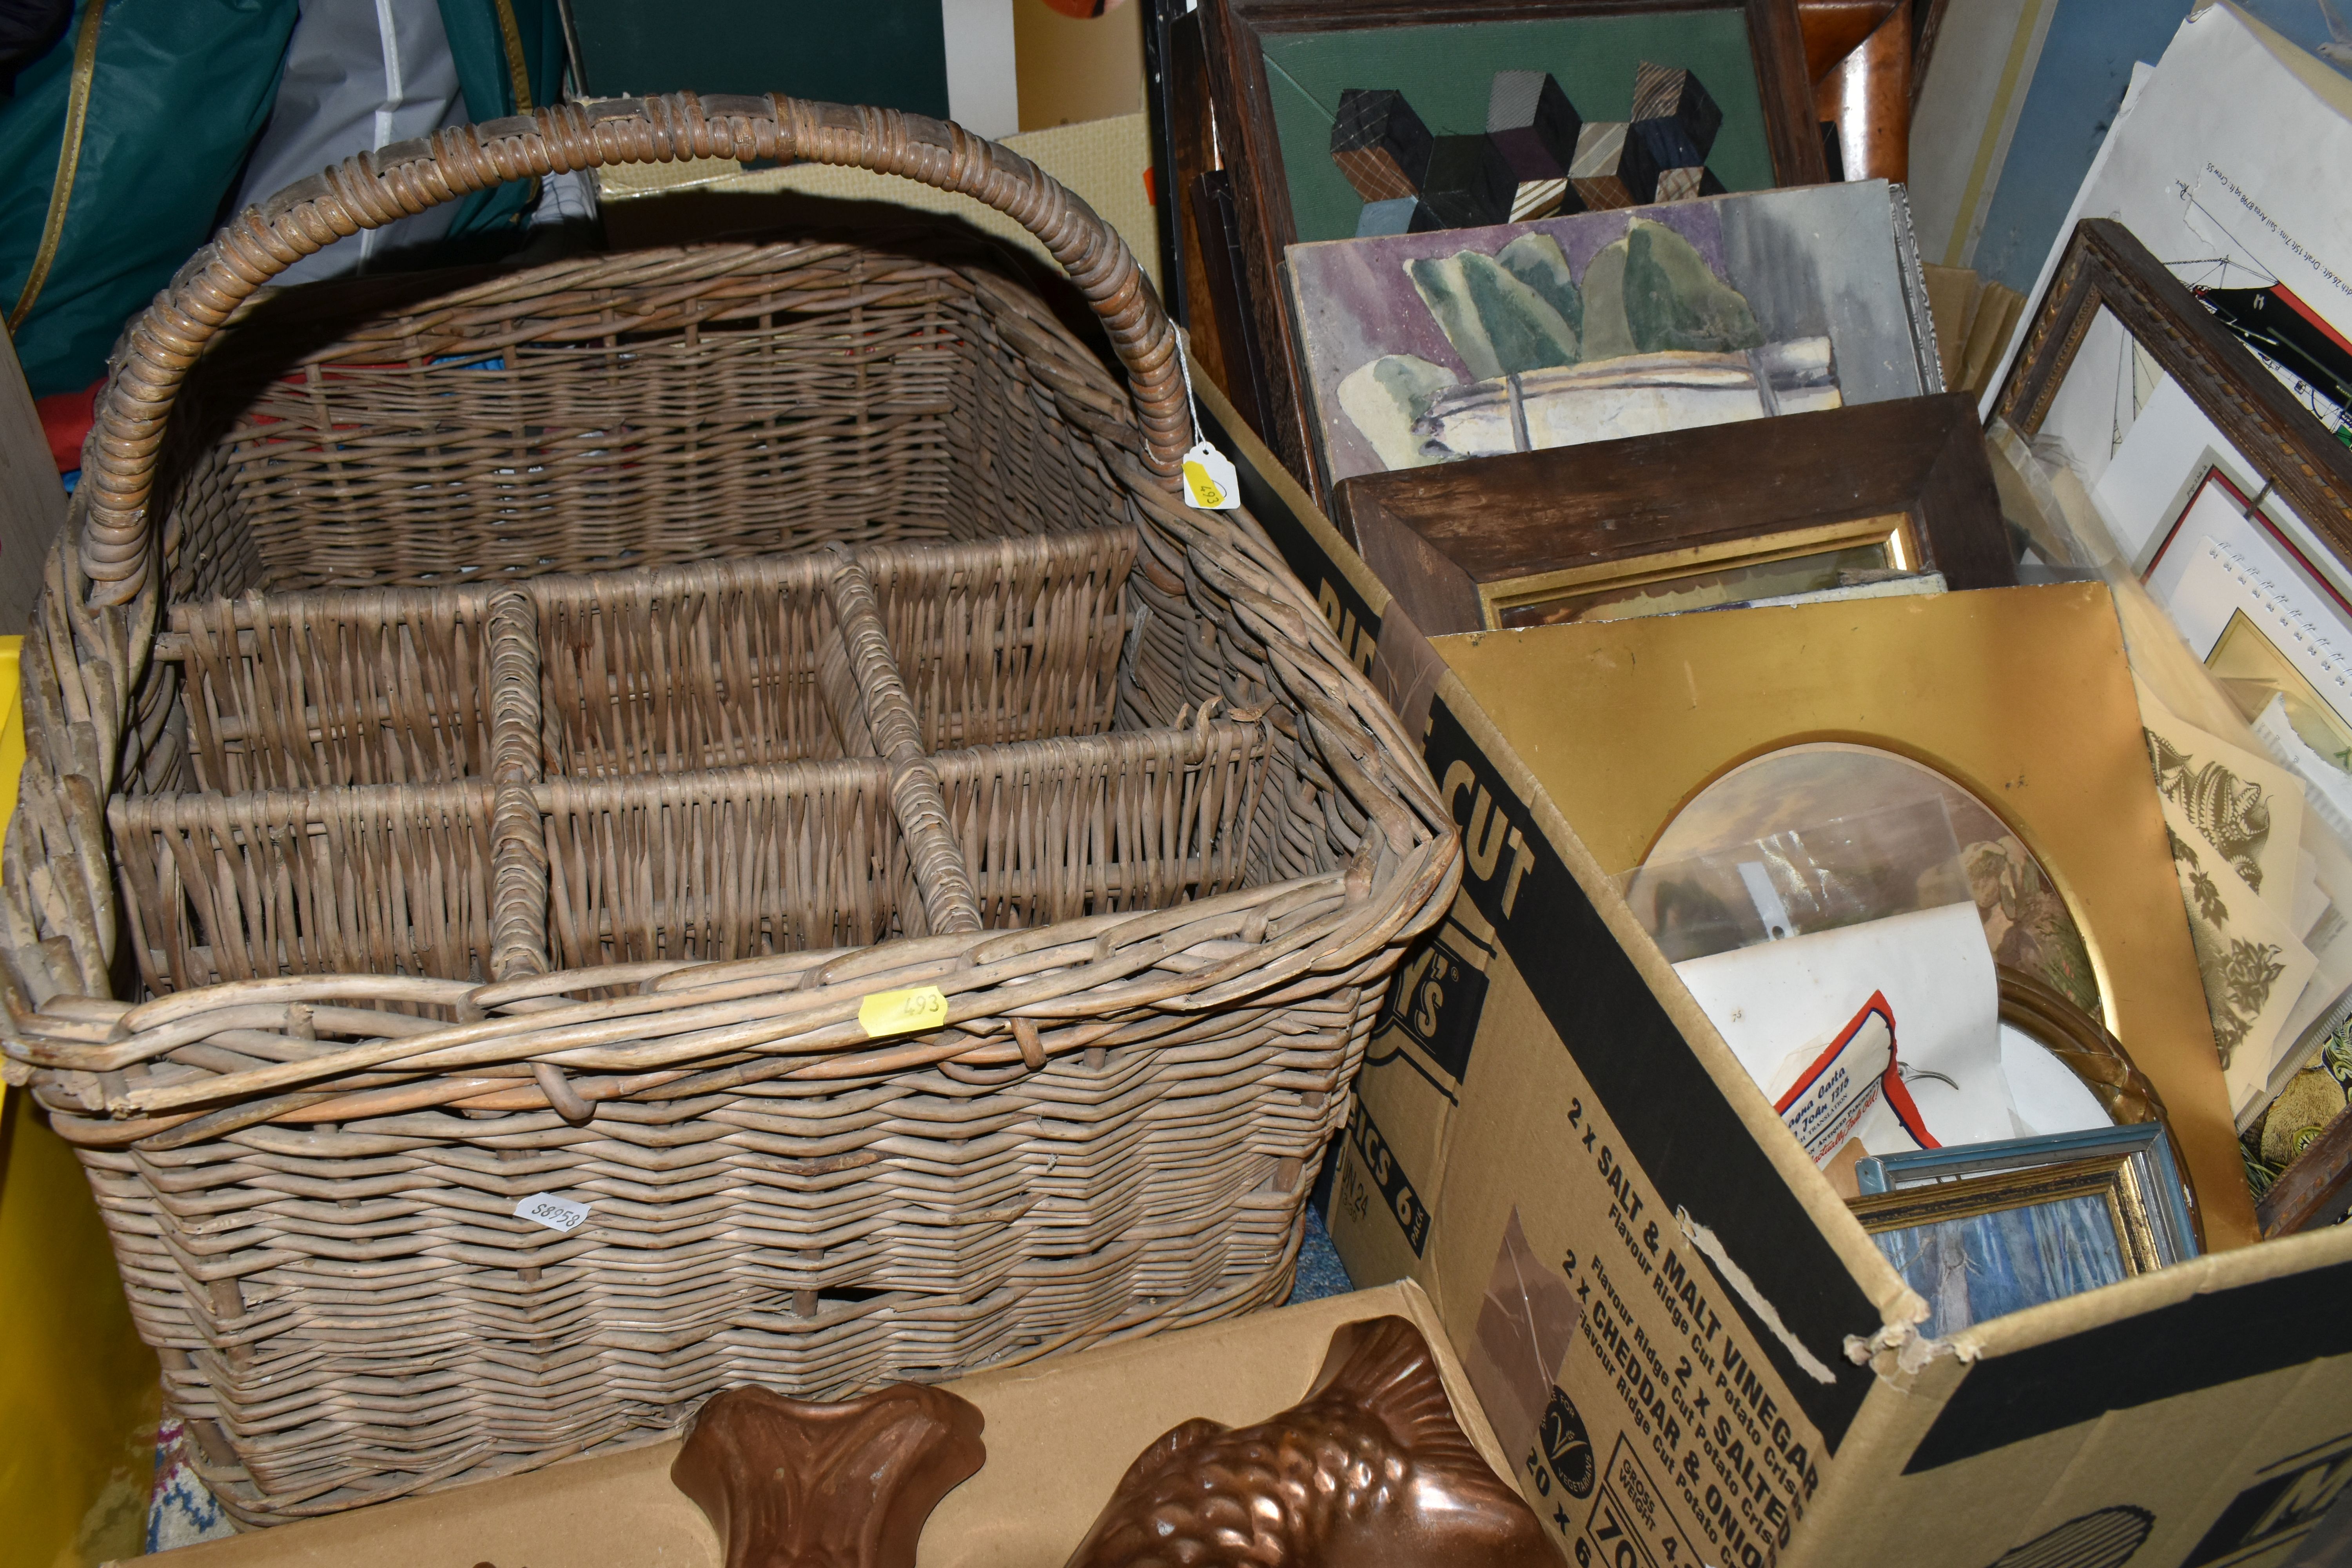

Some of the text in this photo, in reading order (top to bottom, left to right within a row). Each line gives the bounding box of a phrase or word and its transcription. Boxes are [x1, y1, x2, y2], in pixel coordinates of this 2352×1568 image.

[2214, 169, 2228, 185] Crew
[2240, 194, 2254, 211] 8798
[2254, 206, 2267, 222] Area
[2266, 219, 2278, 232] Sail
[2291, 240, 2304, 256] 15ft
[2304, 251, 2321, 270] Draft
[2339, 283, 2352, 299] dth
[1200, 486, 1219, 504] 493
[1441, 759, 1535, 920] CUT
[904, 994, 940, 1016] 493
[1788, 1067, 1846, 1129] agna Carta
[1802, 1076, 1849, 1132] John 1215
[1808, 1093, 1847, 1135] TRANSLATION
[1817, 1117, 1847, 1148] ANTIQUED
[1354, 1182, 1368, 1220] 24
[1396, 1186, 1412, 1226] 6
[1411, 1207, 1424, 1247] PACK
[1568, 1097, 1819, 1503] 2 x SALT & MALT VINEGAR
[1608, 1202, 1653, 1276] Flavour
[1652, 1273, 1689, 1335] Ridge
[1691, 1333, 1715, 1376] Cut
[1715, 1370, 1762, 1446] Potato
[1591, 1254, 1634, 1327] Flavour
[1633, 1324, 1670, 1387] Ridge
[1671, 1385, 1695, 1427] Cut
[1694, 1422, 1739, 1497] Potato
[1560, 1395, 1575, 1419] FOR
[1562, 1248, 1765, 1568] 2 x CHEDDAR & ONIO
[1616, 1374, 1651, 1436] Ridge
[1653, 1434, 1676, 1475] Cut
[1675, 1471, 1719, 1545] Potato
[1675, 1355, 1791, 1550] 2 x SALTED
[1525, 1445, 1550, 1497] 20
[1552, 1500, 1570, 1537] x
[1558, 1453, 1592, 1494] VEGETARIANS
[1623, 1458, 1655, 1515] GROSS
[1619, 1467, 1657, 1532] WEIGHT
